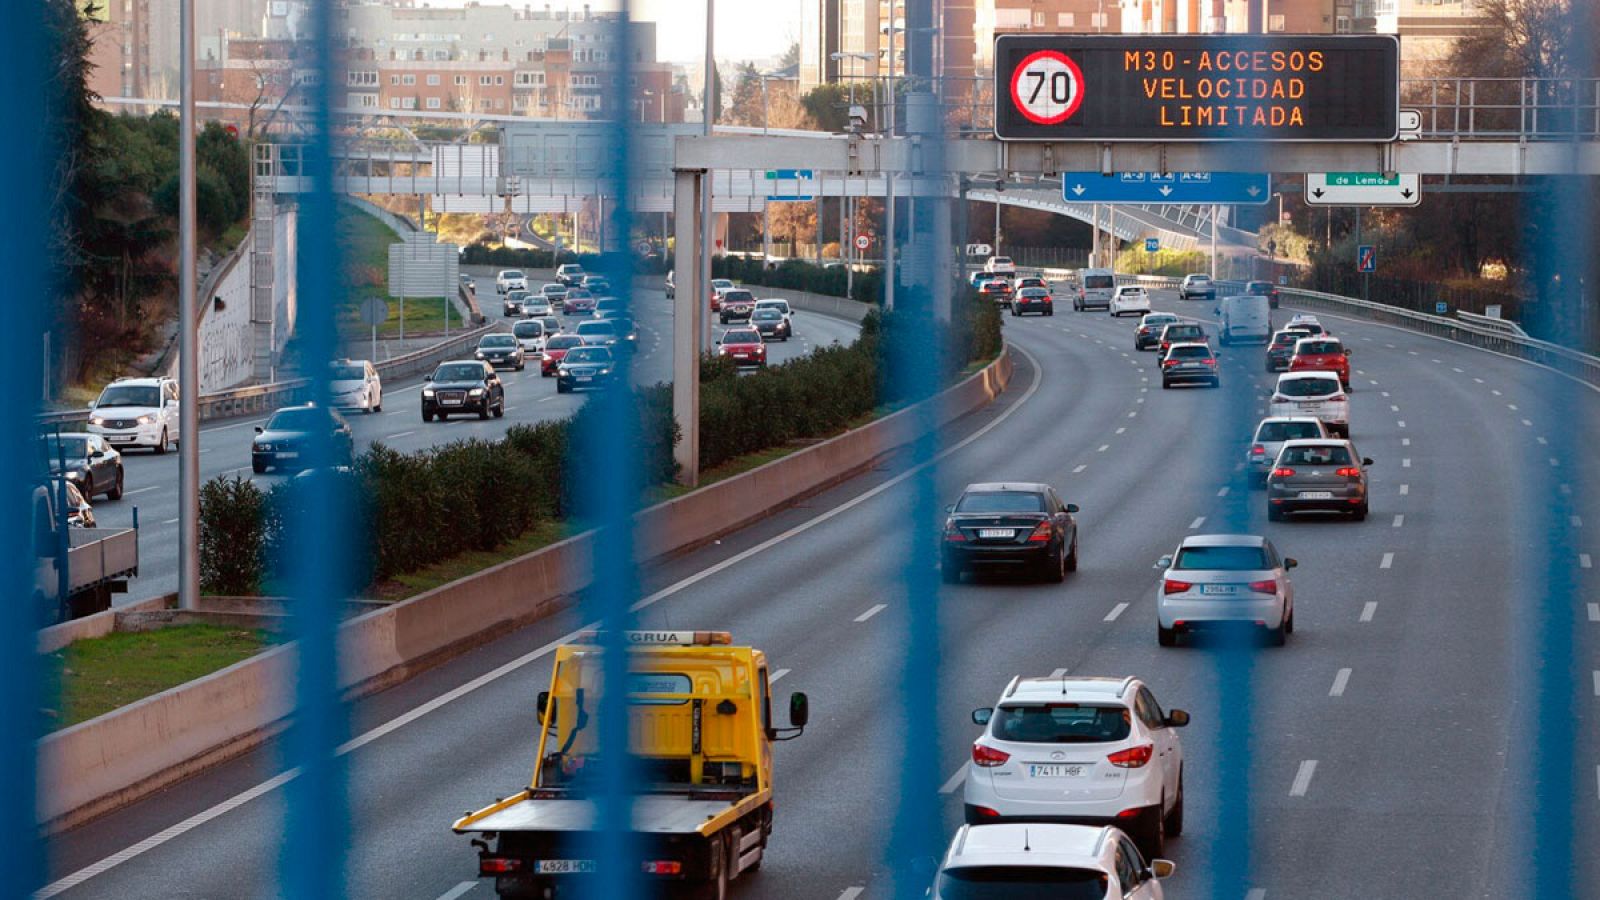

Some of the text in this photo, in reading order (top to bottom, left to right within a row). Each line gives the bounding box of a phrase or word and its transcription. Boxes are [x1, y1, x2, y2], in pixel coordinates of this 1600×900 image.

[1124, 50, 1324, 72] M30-ACCESOS
[1026, 71, 1071, 104] 70
[1143, 78, 1305, 98] VELOCIDAD
[1160, 105, 1304, 126] LIMITADA
[1335, 176, 1349, 185] de
[629, 632, 679, 642] GRUA
[1037, 766, 1082, 777] 7411 HBF
